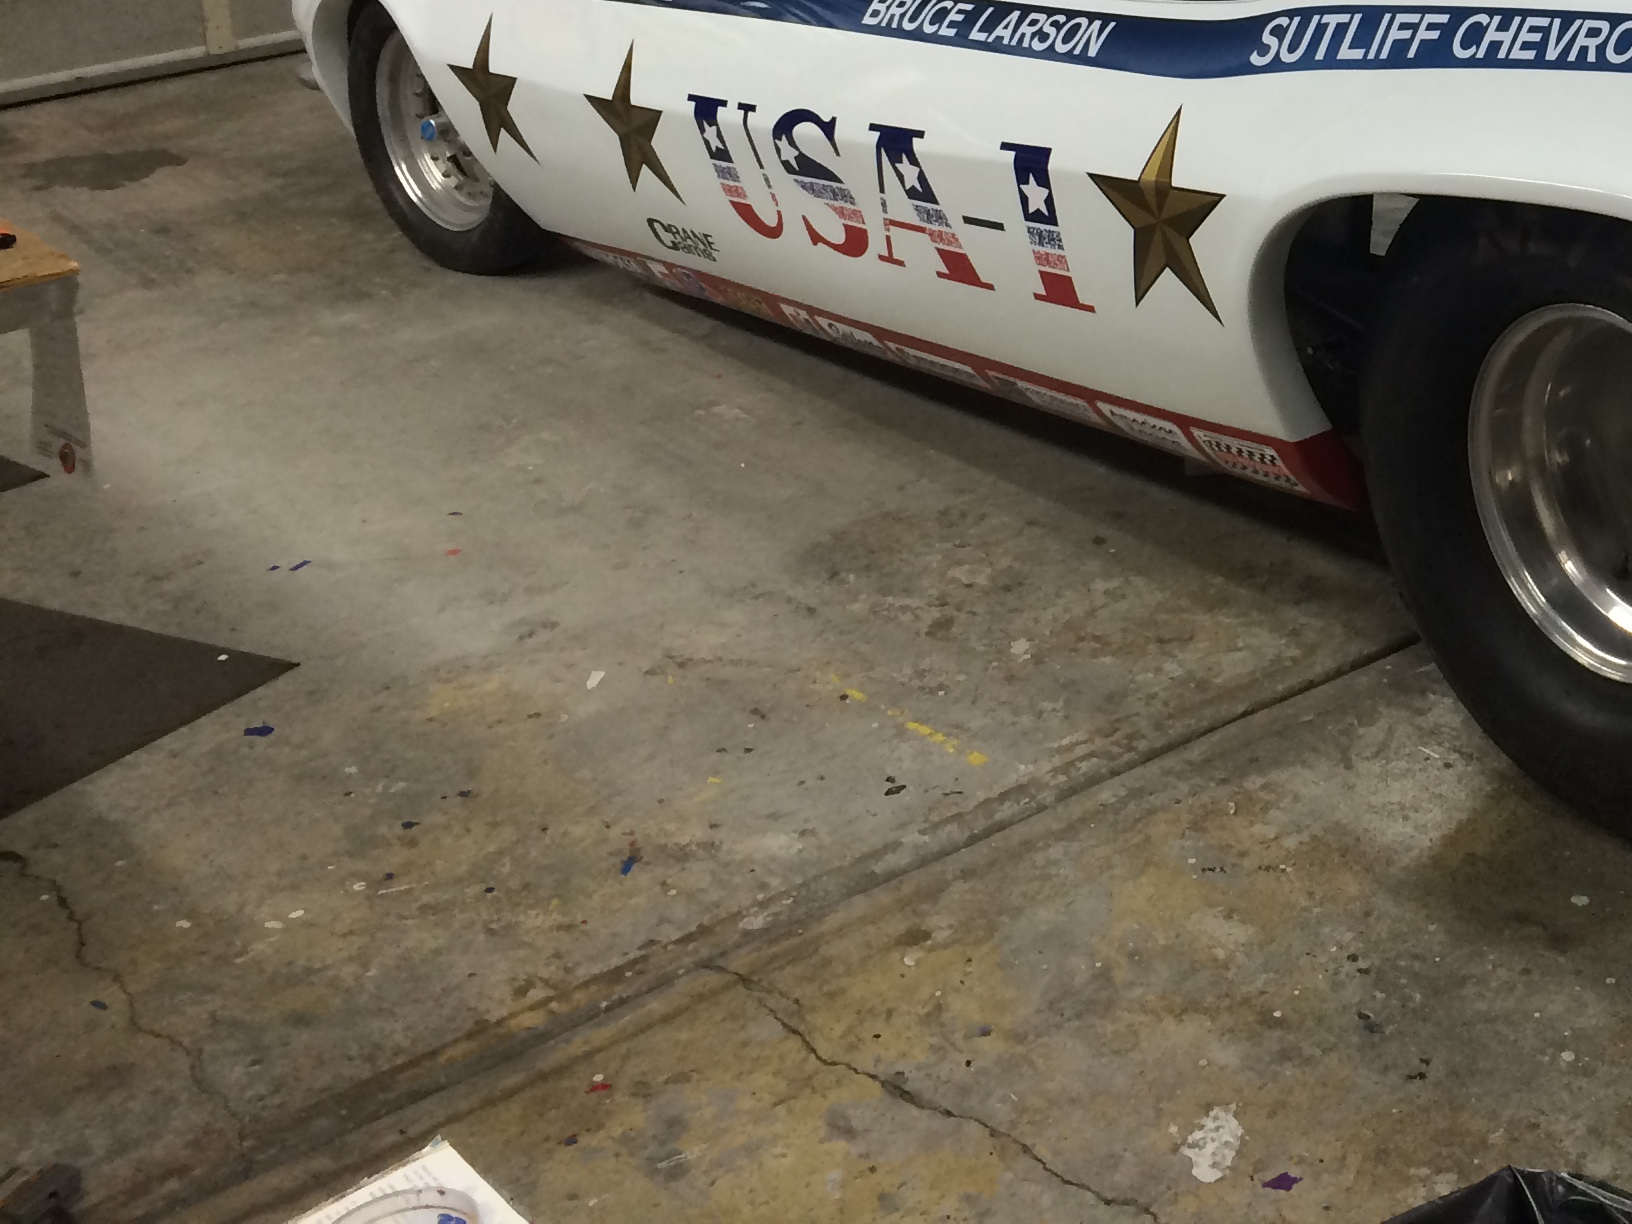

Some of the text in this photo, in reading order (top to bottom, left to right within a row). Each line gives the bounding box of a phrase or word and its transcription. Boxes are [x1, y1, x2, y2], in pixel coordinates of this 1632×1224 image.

[969, 6, 1116, 58] LARSON
[1250, 13, 1450, 65] SUTLIFF
[688, 93, 1097, 314] USA-1
[646, 217, 721, 253] CRANE
